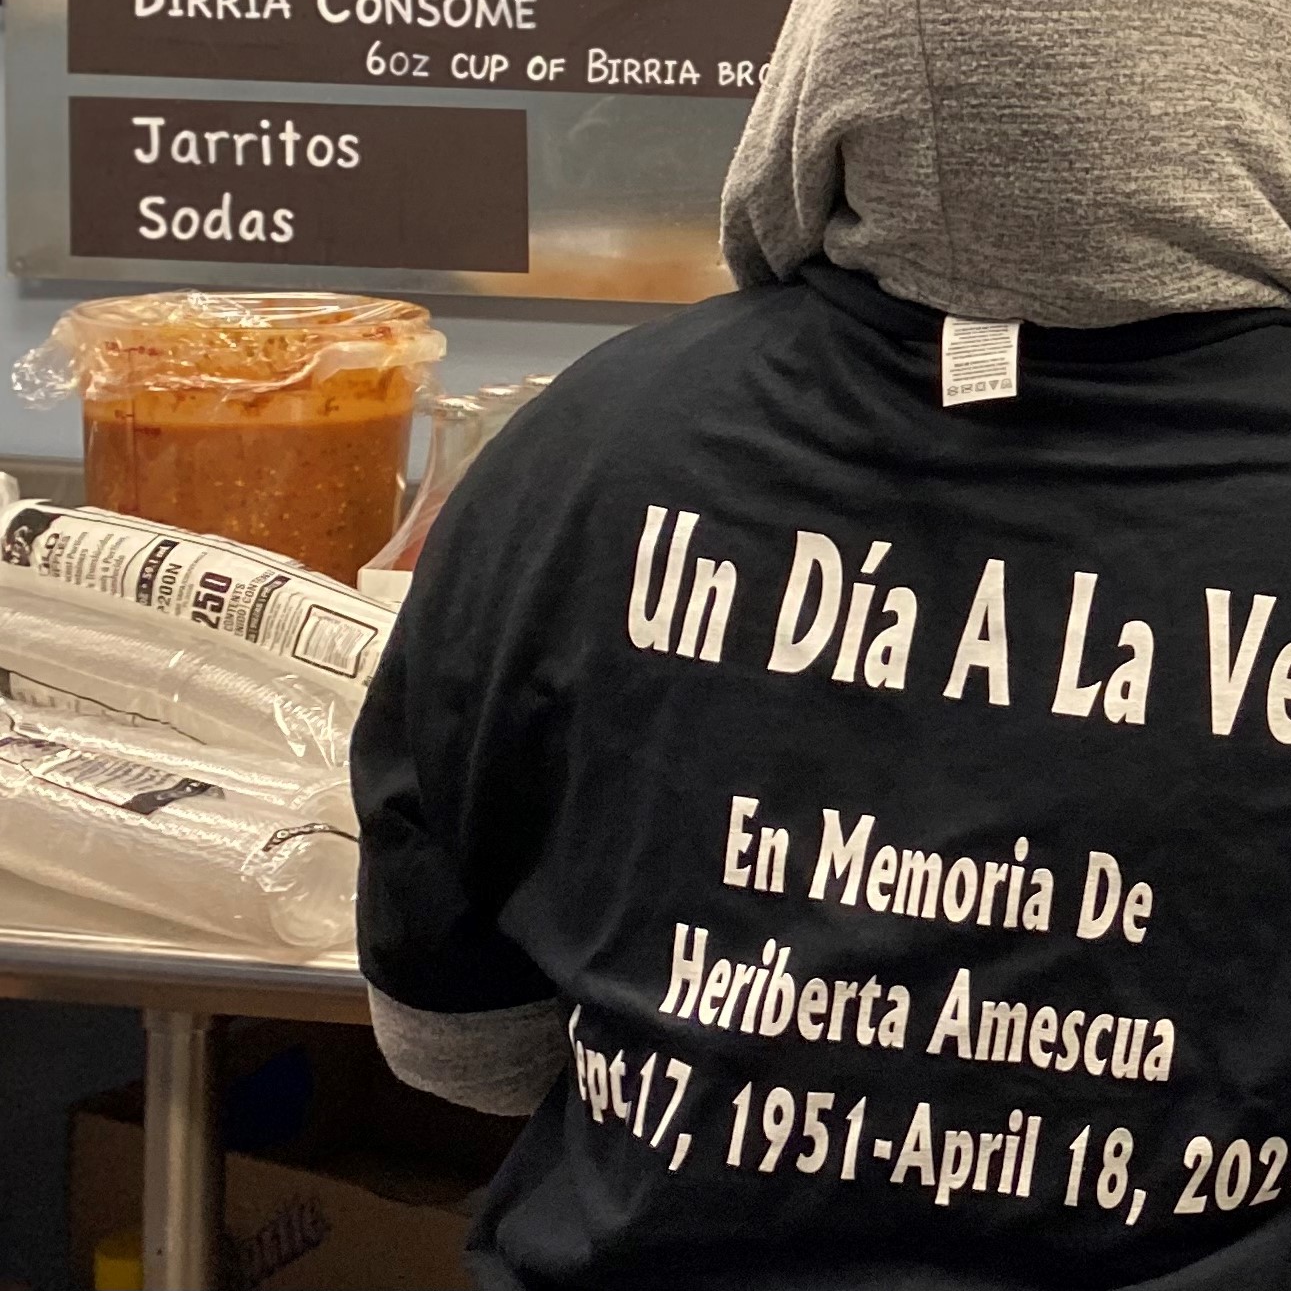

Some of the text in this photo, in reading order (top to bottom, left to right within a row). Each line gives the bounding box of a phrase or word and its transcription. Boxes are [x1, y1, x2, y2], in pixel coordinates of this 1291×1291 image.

[450, 52, 509, 83] CUP
[526, 55, 566, 81] OF
[587, 47, 701, 85] BIRRIA
[131, 116, 360, 169] Jarritos
[138, 191, 295, 243] Sodas
[191, 571, 232, 630] 250
[627, 504, 737, 662] Un
[766, 530, 918, 690] Día
[942, 558, 1011, 706] A
[1050, 571, 1155, 725] La
[722, 795, 1153, 944] En Memoria De
[658, 922, 1175, 1082] Heriberta Amescua
[725, 1081, 1043, 1207] 1951-April
[1063, 1124, 1147, 1226] 18,
